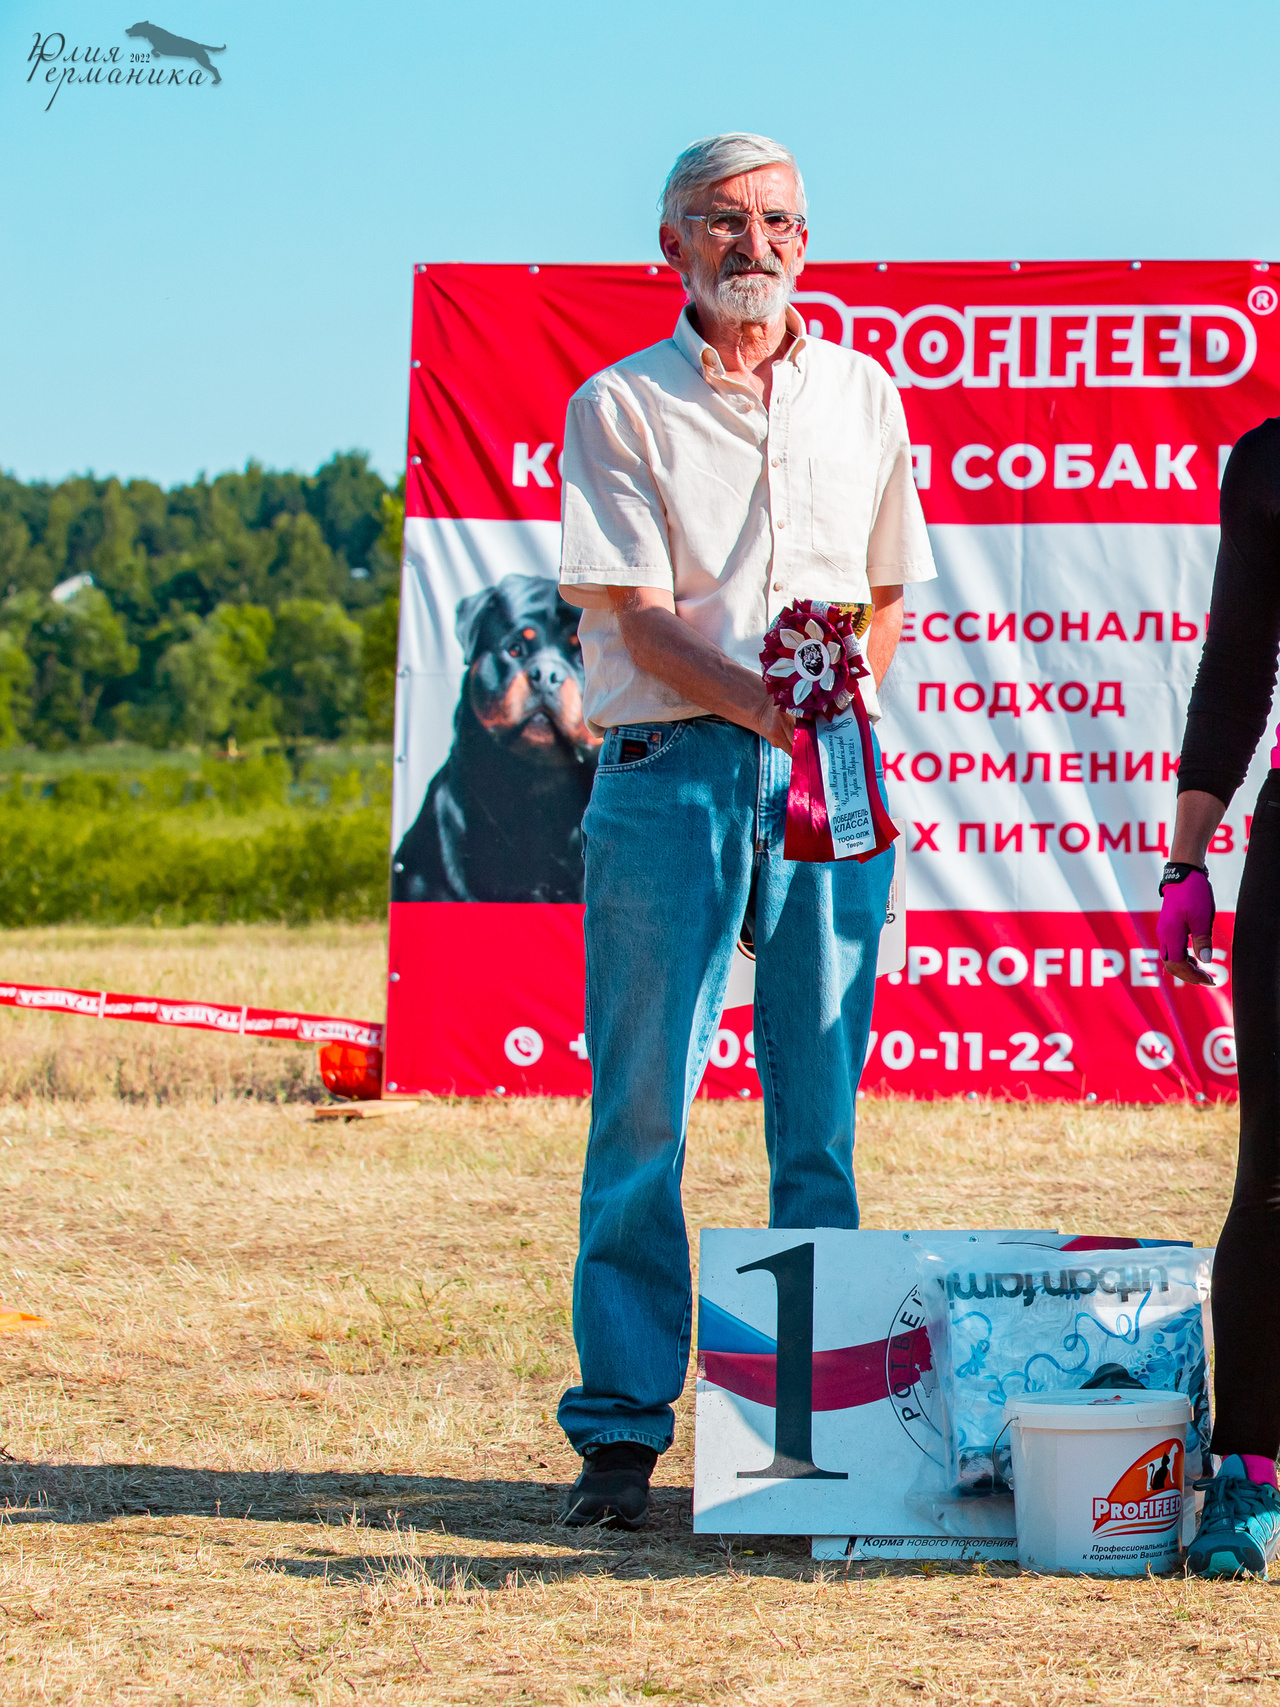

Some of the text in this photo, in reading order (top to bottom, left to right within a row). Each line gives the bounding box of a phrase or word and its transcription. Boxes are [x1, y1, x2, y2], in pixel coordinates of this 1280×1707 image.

[951, 443, 1199, 491] СОБАК
[918, 682, 1126, 719] ПОДХОД
[832, 808, 869, 825] ПОБЕДИТЕЛЬ
[834, 817, 869, 834] КЛАССА
[958, 815, 1252, 857] ПИТОМЦВ!
[887, 946, 1230, 987] .PROFIPES
[19, 989, 98, 1013] ТРАПЕЗА
[160, 1005, 240, 1030] ТРАПЕЗА
[937, 1265, 1170, 1310] urban fami
[736, 1242, 849, 1479] 1
[863, 1537, 904, 1549] Корма
[907, 1538, 949, 1547] нового
[951, 1538, 1014, 1548] поколения
[1092, 1542, 1168, 1553] Профессиональный
[1090, 1552, 1138, 1562] кормлению
